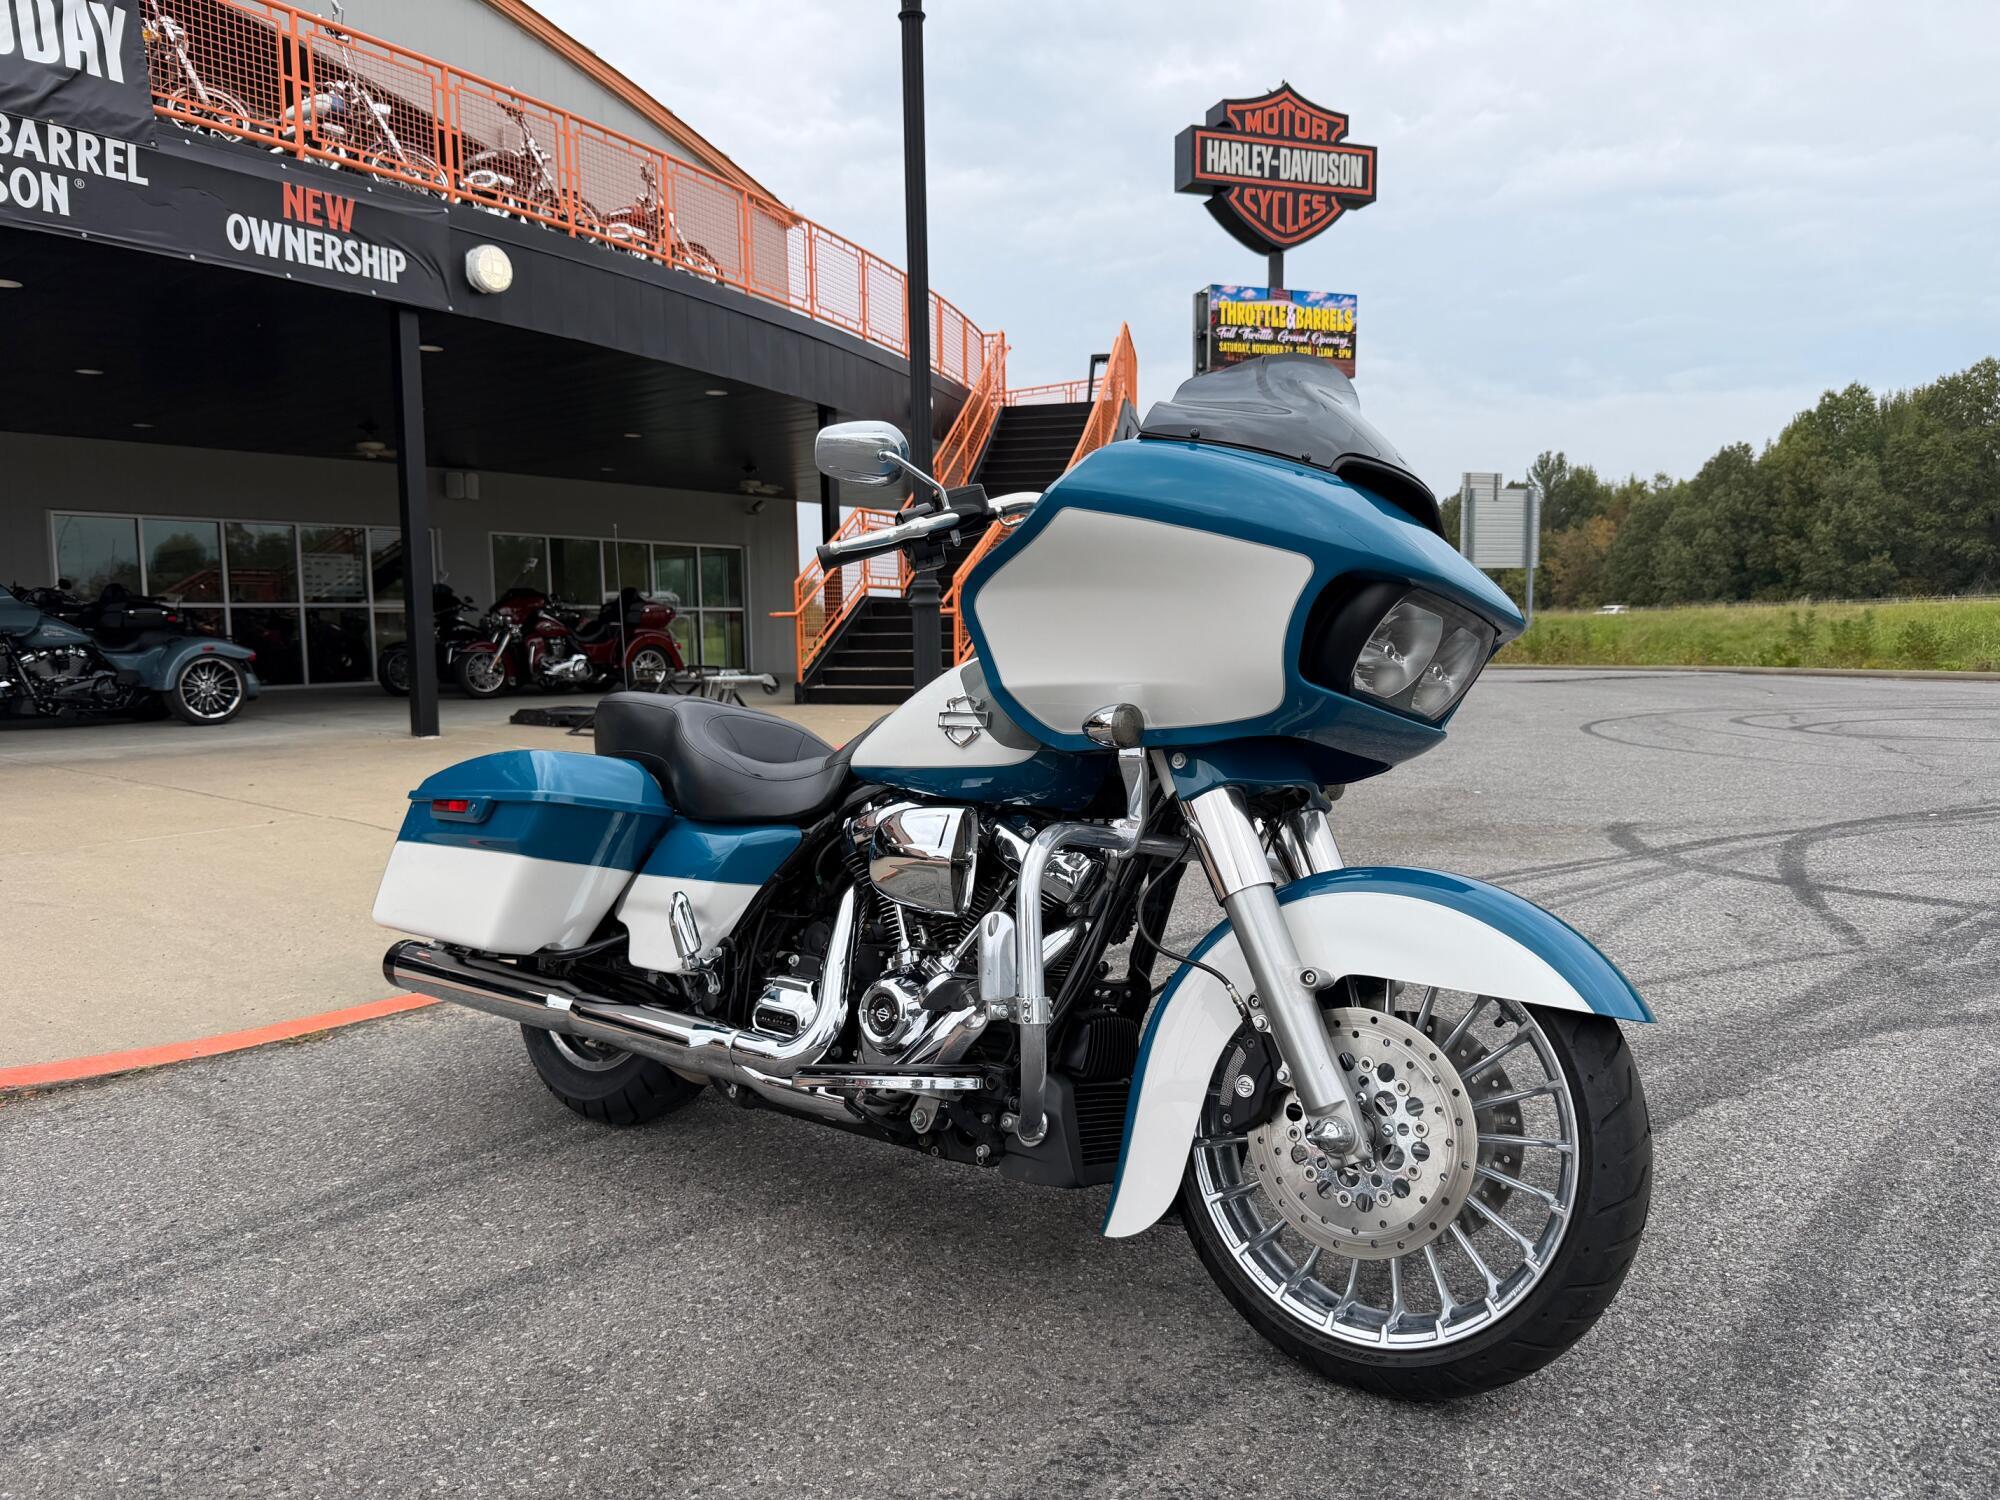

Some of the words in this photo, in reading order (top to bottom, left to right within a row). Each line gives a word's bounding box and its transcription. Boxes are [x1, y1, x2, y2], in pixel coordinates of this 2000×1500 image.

[1244, 100, 1328, 142] MOTOR
[1206, 139, 1363, 188] HARLEY-DAVIDSON
[282, 181, 356, 233] NEW
[1243, 188, 1327, 234] CYCLES
[226, 213, 407, 284] OWNERSHIP
[1216, 327, 1238, 340] Full
[1277, 329, 1309, 344] Grand
[1252, 344, 1284, 355] NOVEMBER
